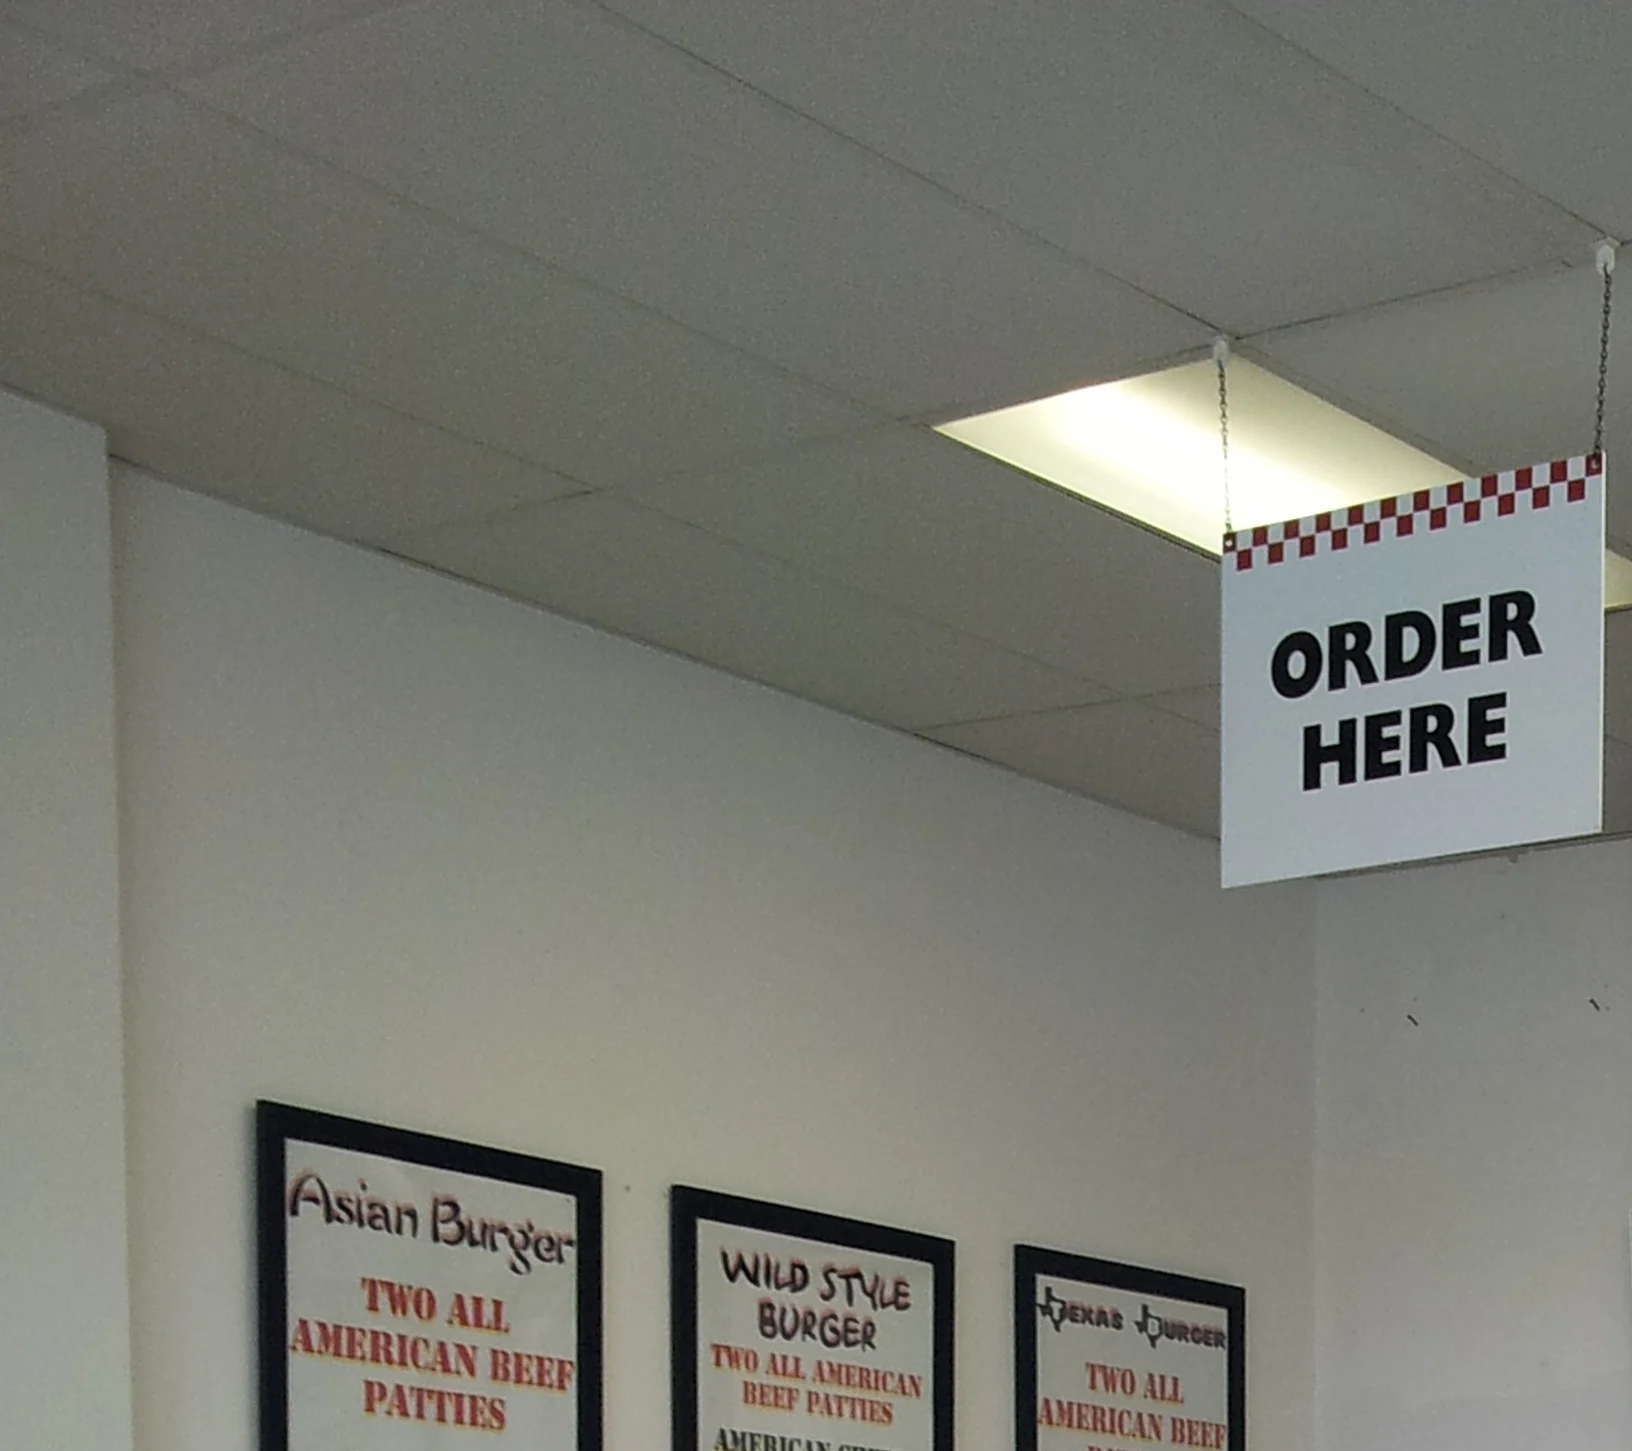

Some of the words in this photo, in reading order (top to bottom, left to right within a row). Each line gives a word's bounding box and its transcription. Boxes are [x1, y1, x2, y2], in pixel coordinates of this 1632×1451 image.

[1271, 590, 1543, 699] ORDER
[1303, 692, 1507, 792] HERE
[290, 1173, 419, 1238] Asian
[431, 1194, 575, 1276] Burger
[361, 1276, 437, 1322] TWO
[446, 1292, 510, 1334] ALL
[720, 1247, 809, 1293] WILD
[819, 1264, 911, 1311] STYLE
[758, 1297, 877, 1351] BURGER
[1036, 1286, 1124, 1332] TEXAS
[1134, 1303, 1227, 1349] BURGER
[291, 1319, 479, 1378] AMERICAN
[489, 1346, 575, 1392] BEEF
[711, 1343, 759, 1372] TWO
[765, 1352, 805, 1380] ALL
[812, 1360, 922, 1399] AMERICAN
[1086, 1361, 1136, 1396] TWO
[1143, 1373, 1184, 1404] ALL
[364, 1379, 506, 1431] PATTIES
[743, 1381, 799, 1410] BEEF
[806, 1391, 893, 1425] PATTIES
[1038, 1397, 1163, 1441] AMERICAN
[1170, 1417, 1227, 1450] BEEF
